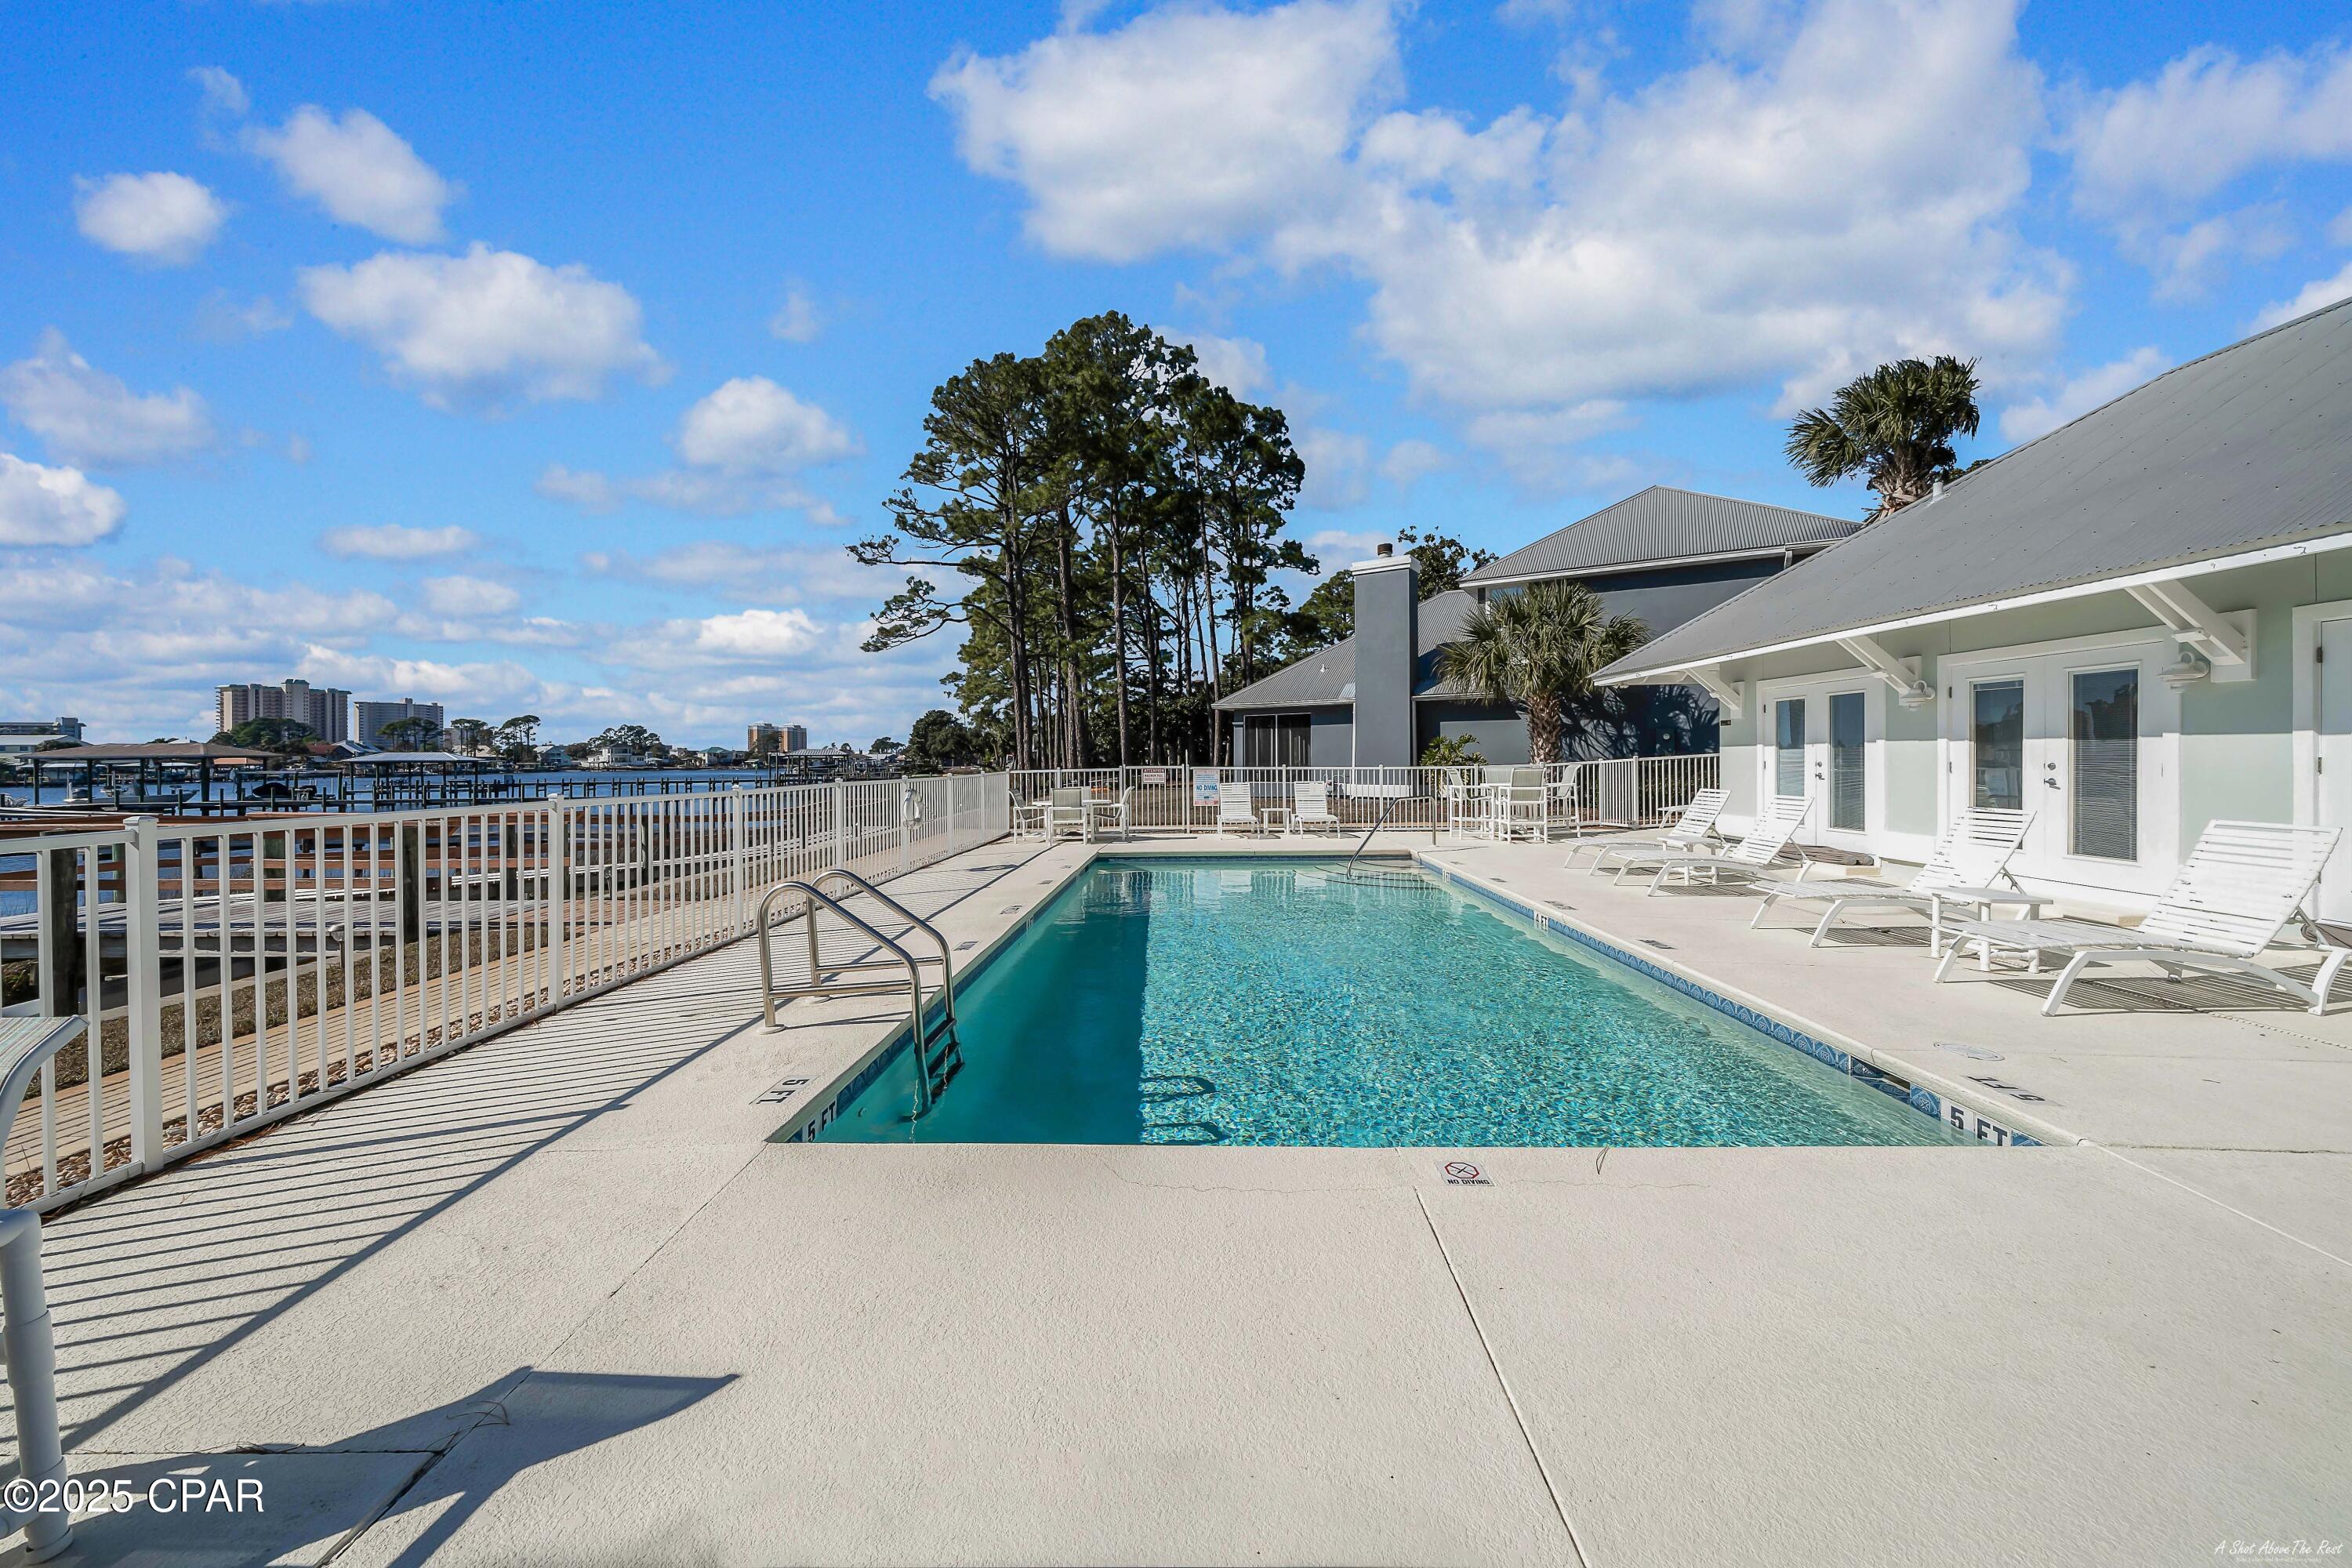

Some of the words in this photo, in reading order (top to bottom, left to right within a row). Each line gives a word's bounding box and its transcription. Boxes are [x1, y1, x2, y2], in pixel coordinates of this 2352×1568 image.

[1965, 1076, 2020, 1090] FT
[755, 1089, 797, 1105] FT
[821, 1101, 836, 1132] FT
[1951, 1105, 1964, 1131] 5
[1976, 1117, 2008, 1147] FT
